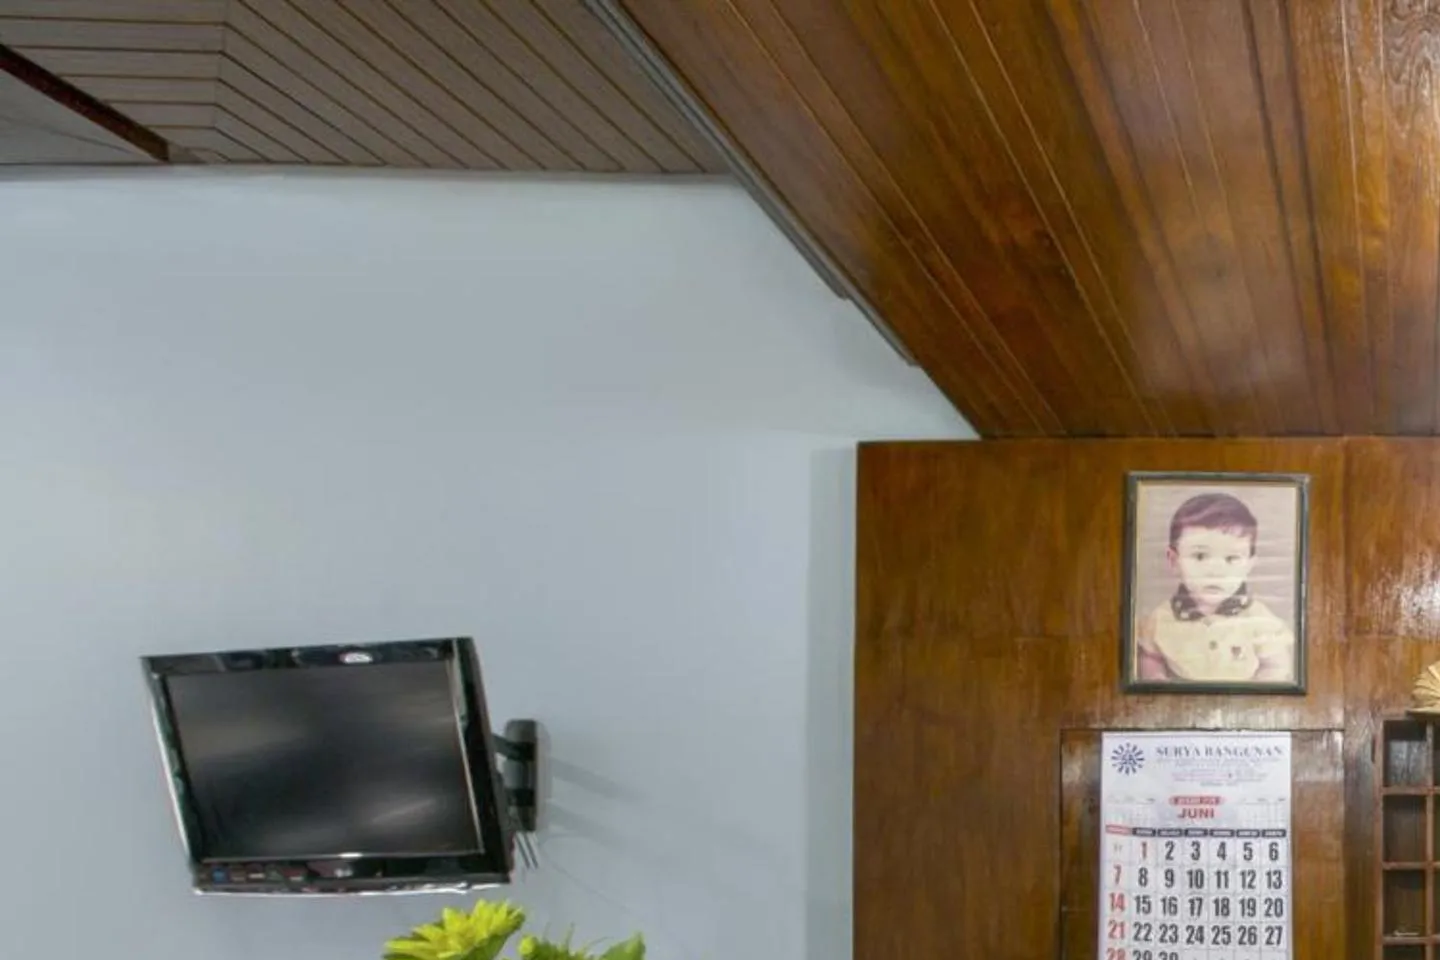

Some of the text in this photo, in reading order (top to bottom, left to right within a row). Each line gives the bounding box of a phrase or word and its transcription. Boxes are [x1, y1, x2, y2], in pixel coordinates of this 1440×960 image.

[1177, 807, 1216, 819] JUNI
[1141, 841, 1148, 860] 1
[1164, 840, 1175, 861] 2
[1190, 840, 1201, 861] 3
[1216, 841, 1228, 861] 4
[1243, 841, 1254, 862] 5
[1268, 841, 1279, 862] 6
[1113, 864, 1283, 890] 7 8 9 10 11 12 13
[1109, 892, 1284, 918] 14 15 16 17 18 19 20
[1108, 919, 1283, 946] 21 22 23 24 25 26 27
